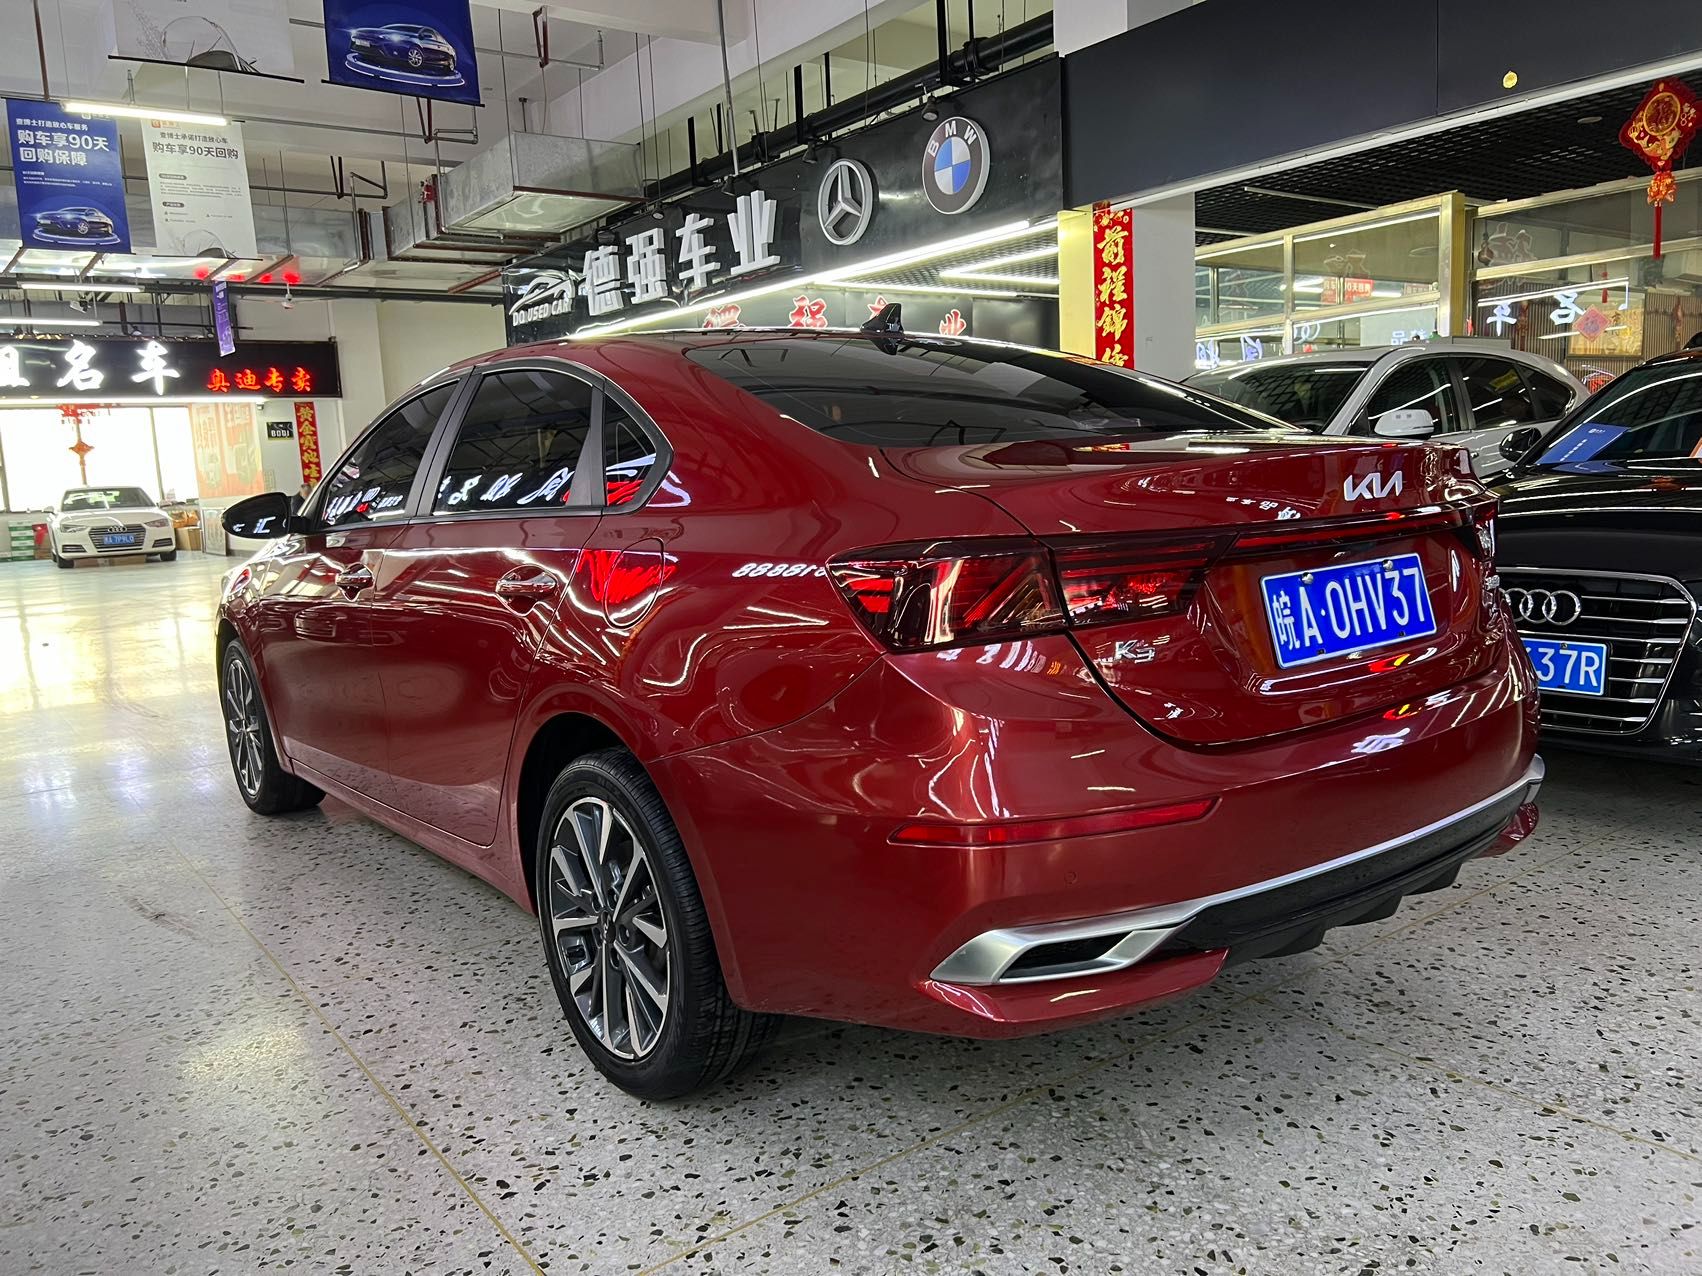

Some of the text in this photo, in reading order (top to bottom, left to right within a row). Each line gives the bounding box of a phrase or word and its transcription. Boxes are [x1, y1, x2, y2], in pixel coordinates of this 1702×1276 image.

[17, 130, 109, 152] 购车享90天
[152, 142, 239, 159] 购车享90天回购
[927, 120, 977, 157] BMW
[20, 147, 88, 166] 回购保障
[583, 190, 781, 316] 德强车业
[528, 303, 551, 321] USED
[552, 299, 573, 315] CAR
[207, 367, 312, 393] 奥迪专卖
[1344, 470, 1403, 501] KIA
[1114, 639, 1155, 664] K3
[1526, 647, 1600, 687] 37R
